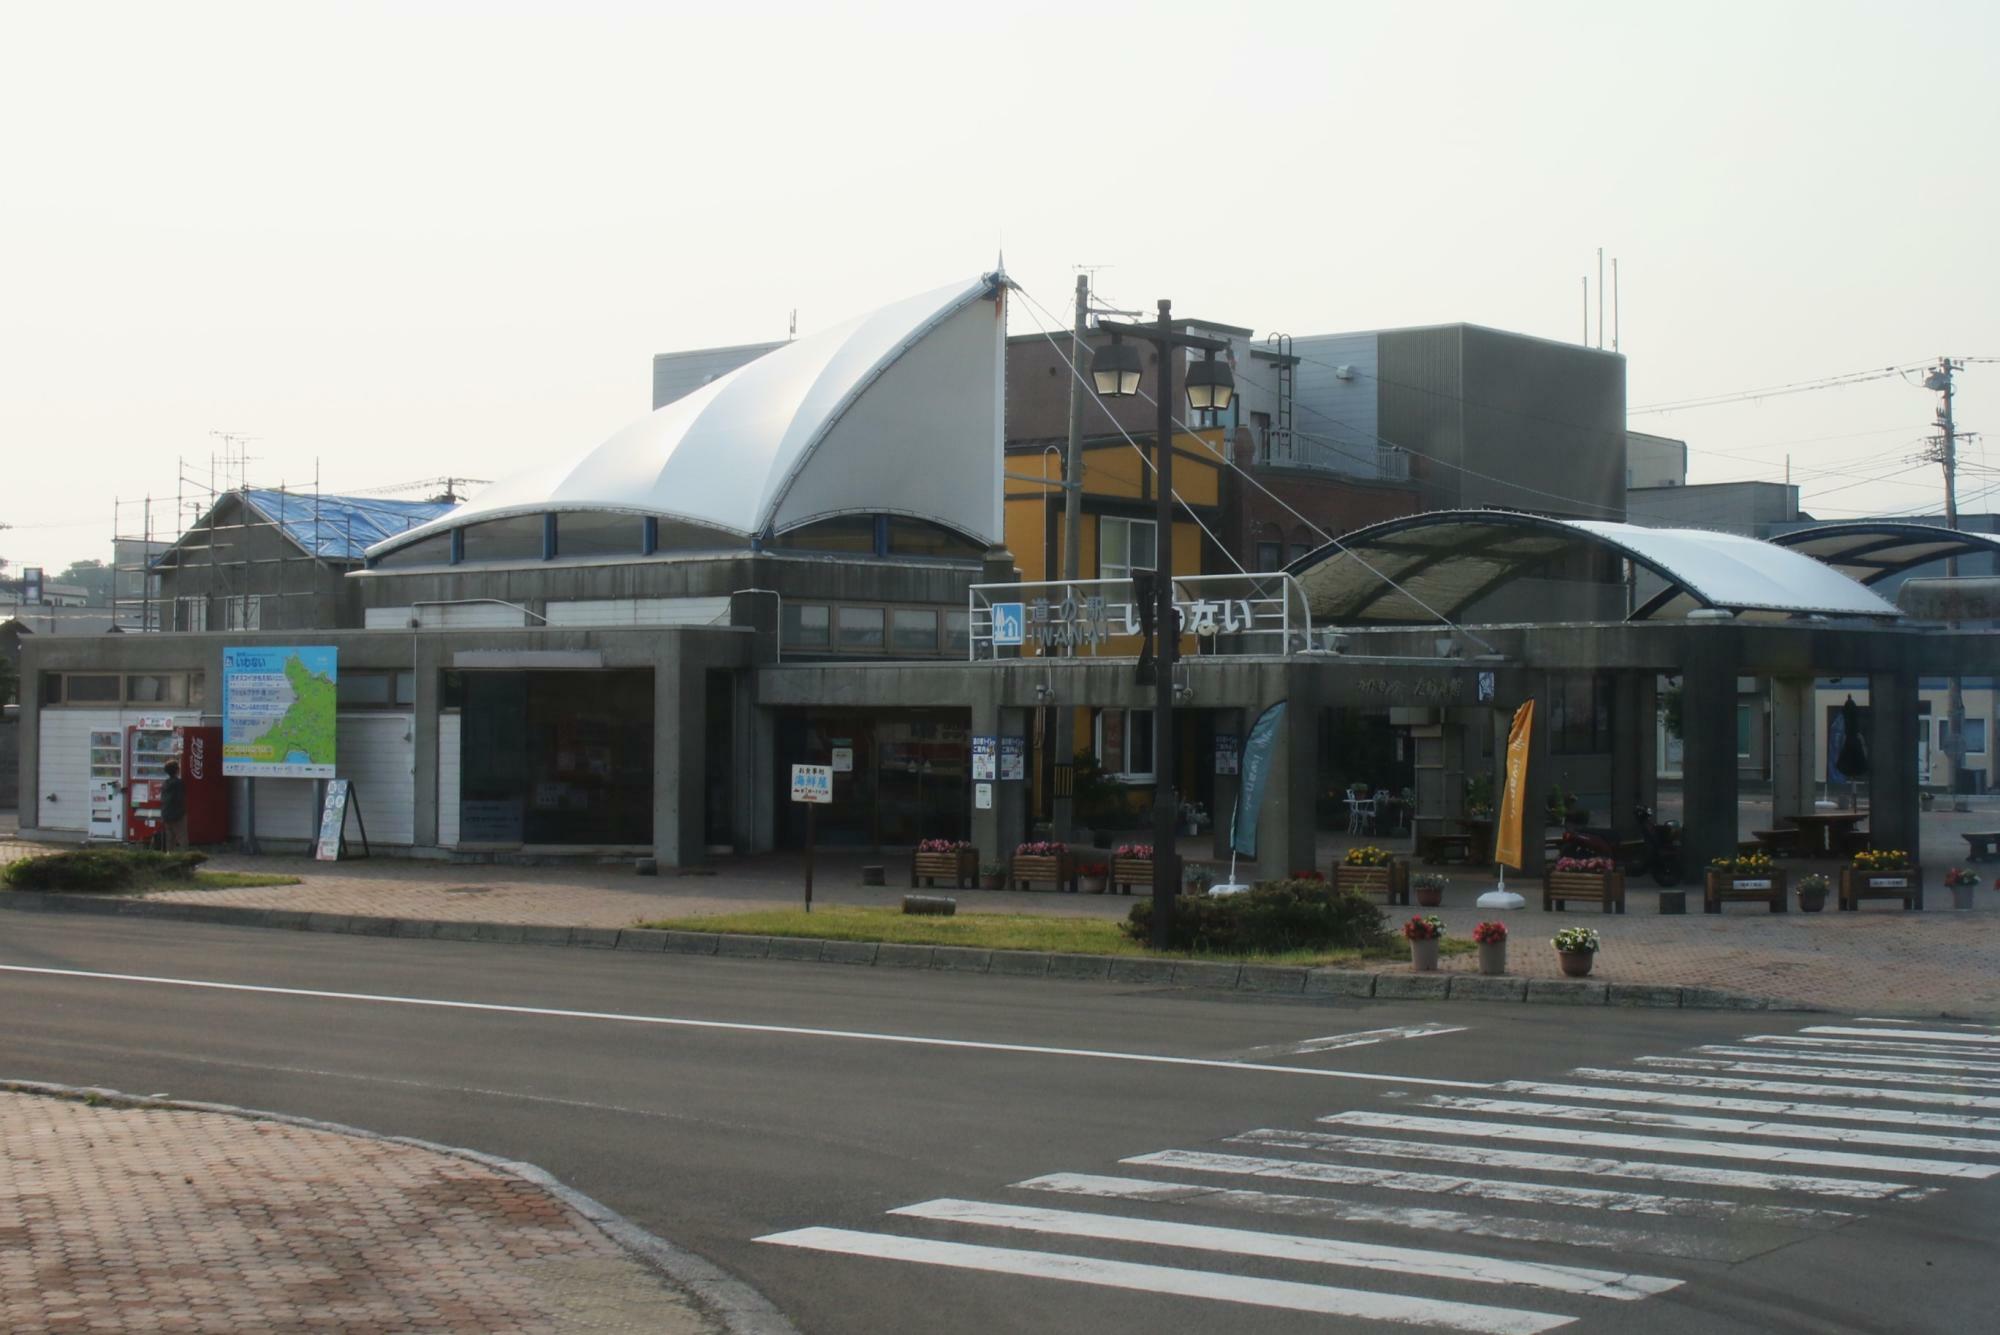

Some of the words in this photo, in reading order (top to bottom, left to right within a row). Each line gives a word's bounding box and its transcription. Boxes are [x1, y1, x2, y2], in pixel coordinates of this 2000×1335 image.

[1032, 596, 1105, 624] 道の駅
[1031, 623, 1109, 647] IWANAI
